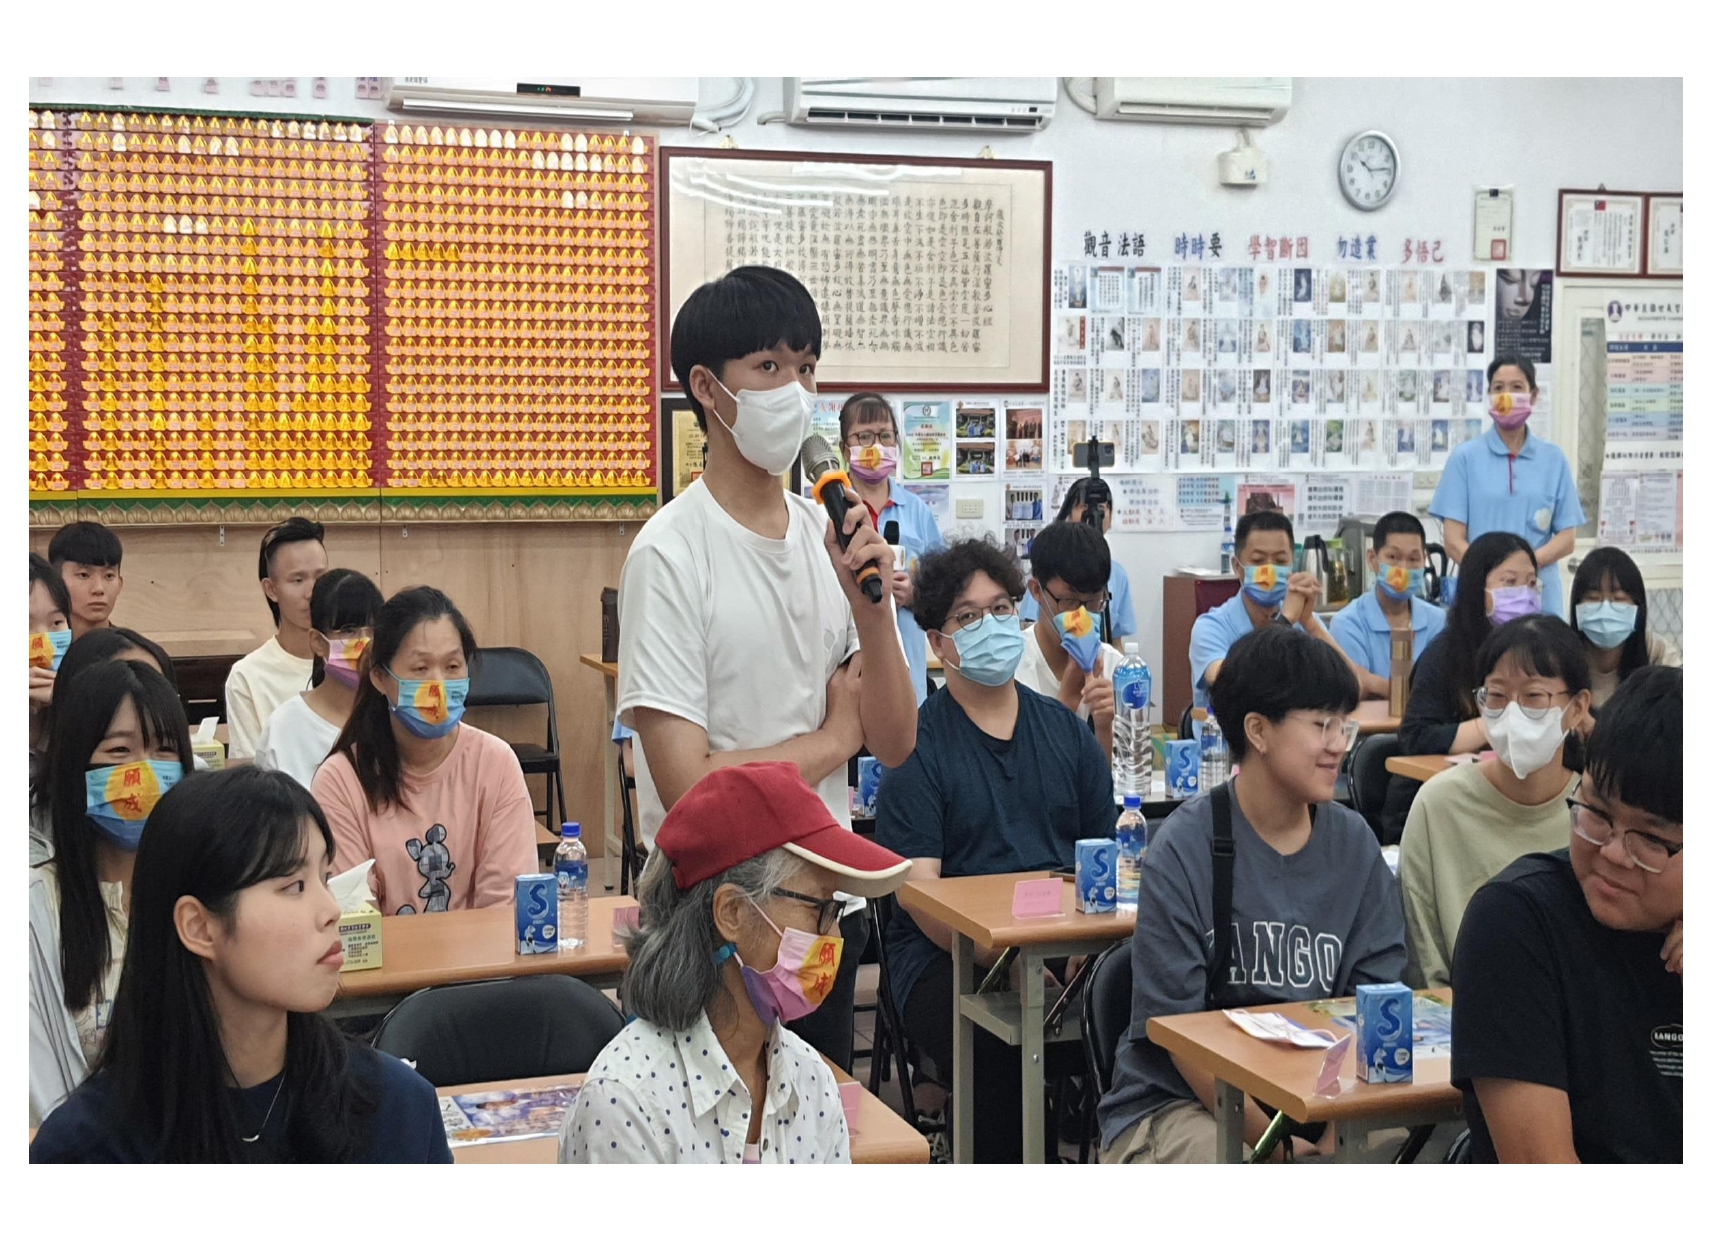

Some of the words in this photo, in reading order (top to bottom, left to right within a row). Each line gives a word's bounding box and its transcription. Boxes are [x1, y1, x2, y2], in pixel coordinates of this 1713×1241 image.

[1174, 232, 1223, 260] 時時要
[1248, 234, 1309, 261] 學智斷因
[1091, 848, 1110, 881] S
[528, 883, 549, 918] S
[1206, 921, 1343, 993] ANGO
[1376, 998, 1402, 1042] S
